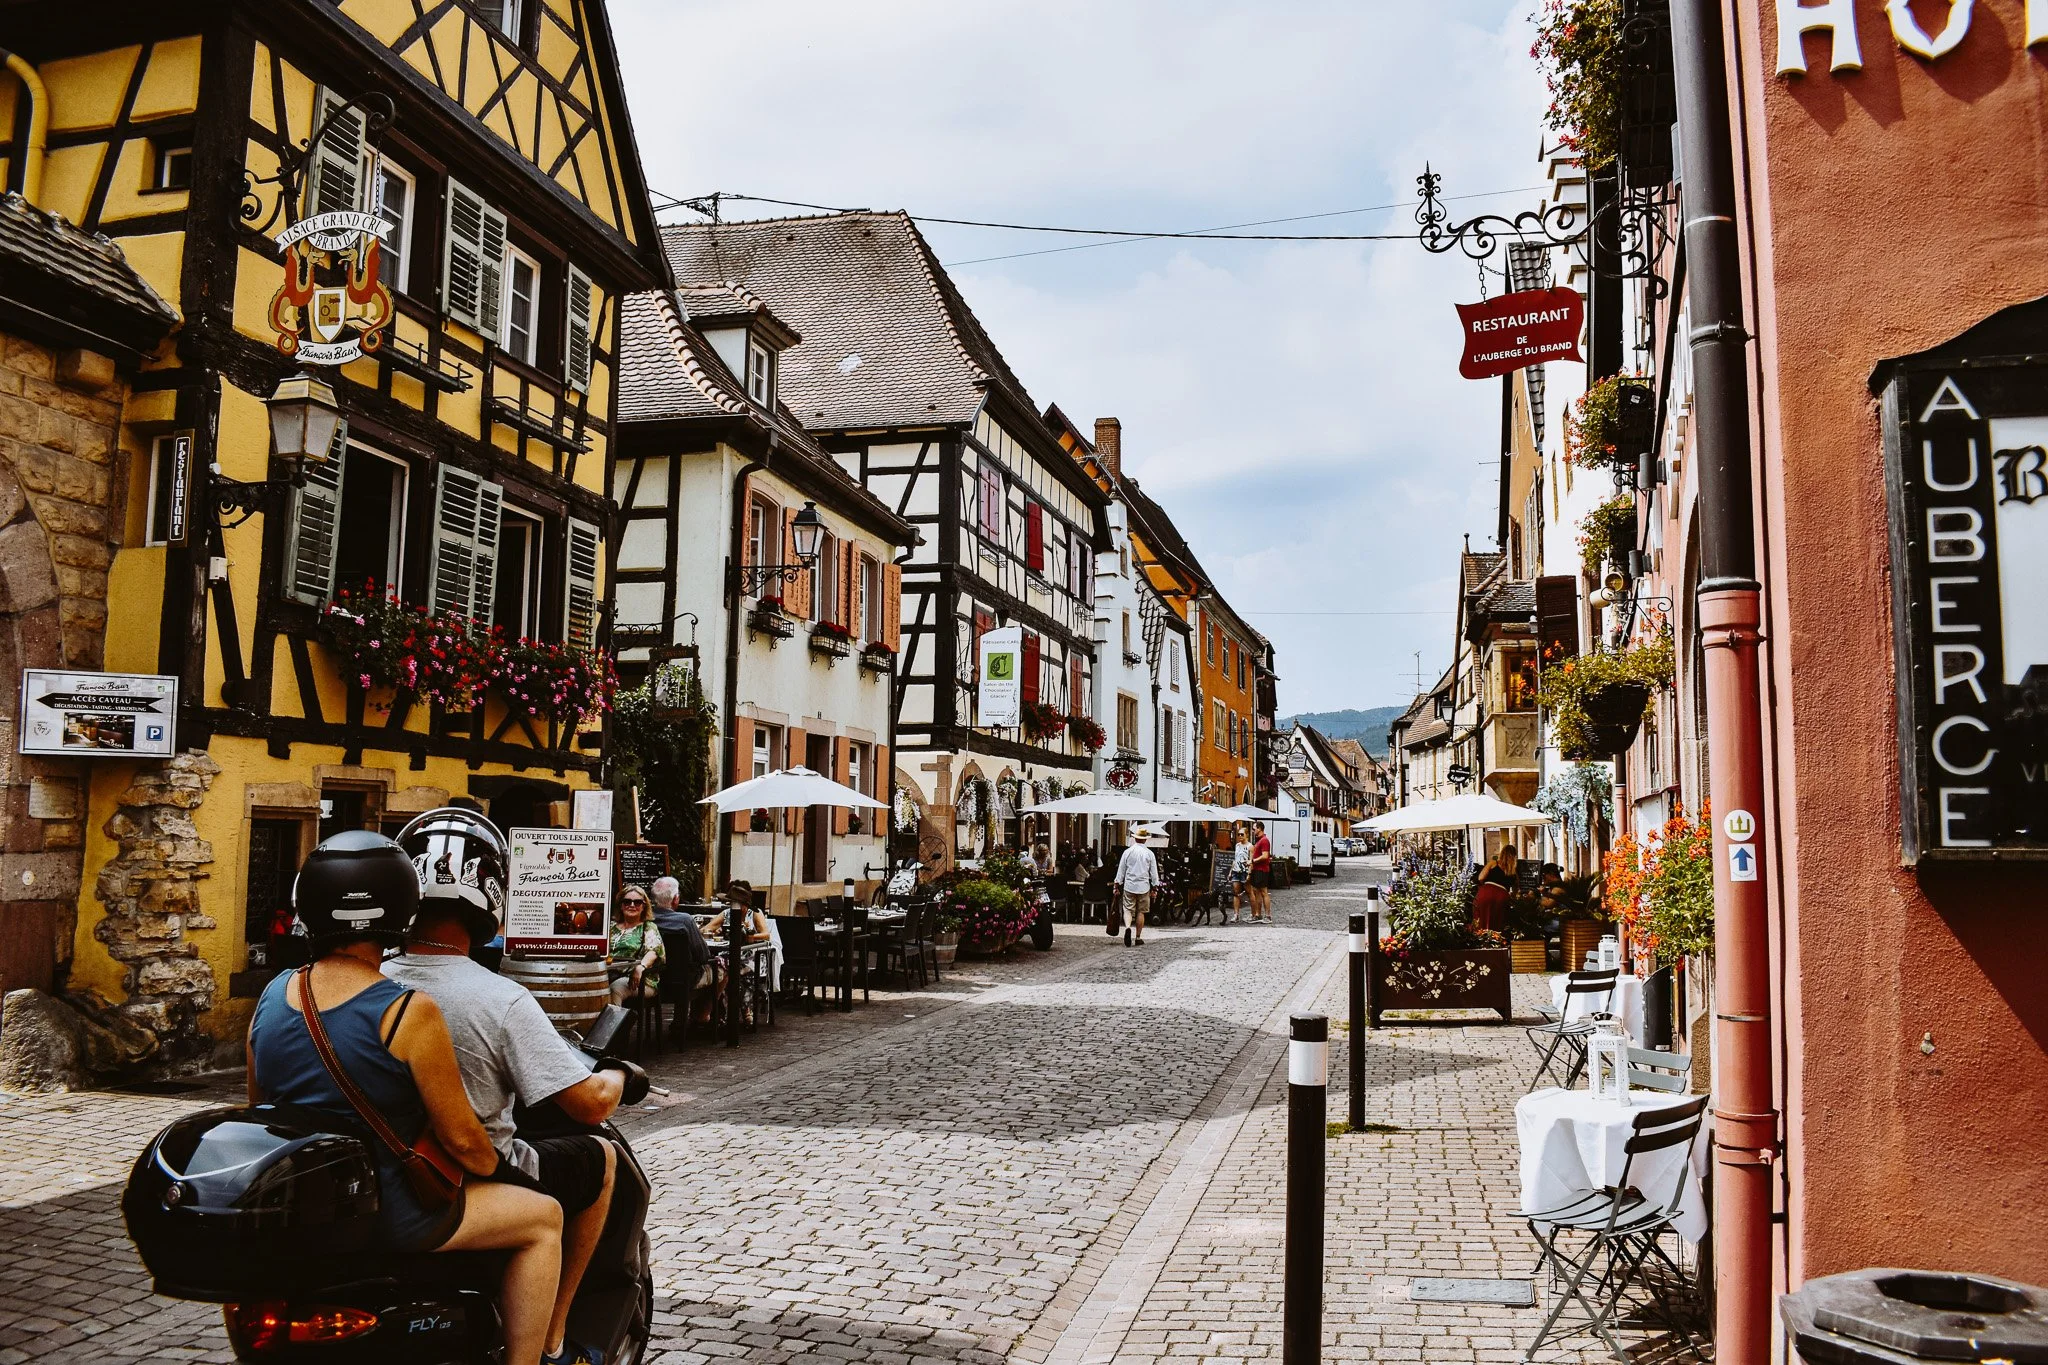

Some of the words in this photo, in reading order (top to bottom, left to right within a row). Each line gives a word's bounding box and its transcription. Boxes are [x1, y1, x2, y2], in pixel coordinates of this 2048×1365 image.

[1776, 0, 2048, 76] HO
[282, 217, 320, 246] ALSACE
[322, 213, 360, 227] GRAND
[362, 217, 385, 234] CRU
[315, 234, 351, 250] BRAND
[1472, 307, 1570, 333] RESTAURANT
[1516, 336, 1528, 345] DE
[300, 345, 332, 360] François
[333, 346, 359, 360] Baur
[1473, 348, 1522, 363] L'AUBERGE
[1524, 346, 1538, 356] DU
[1540, 341, 1573, 353] BRAND
[173, 441, 187, 536] restaurant
[1919, 375, 1999, 847] AUBERGE
[106, 681, 130, 691] Baur
[54, 702, 89, 710] DÉGUSTATION
[70, 694, 96, 703] ACCÈS
[515, 832, 547, 840] OUVERT
[548, 833, 568, 841] TOUS
[518, 872, 565, 885] François
[565, 866, 600, 880] Baur
[512, 889, 573, 898] DEGUSTATION
[578, 891, 606, 899] VENTE
[515, 942, 598, 951] www.vinsbaur.com
[408, 1315, 440, 1333] FLY
[440, 1321, 452, 1329] 125
